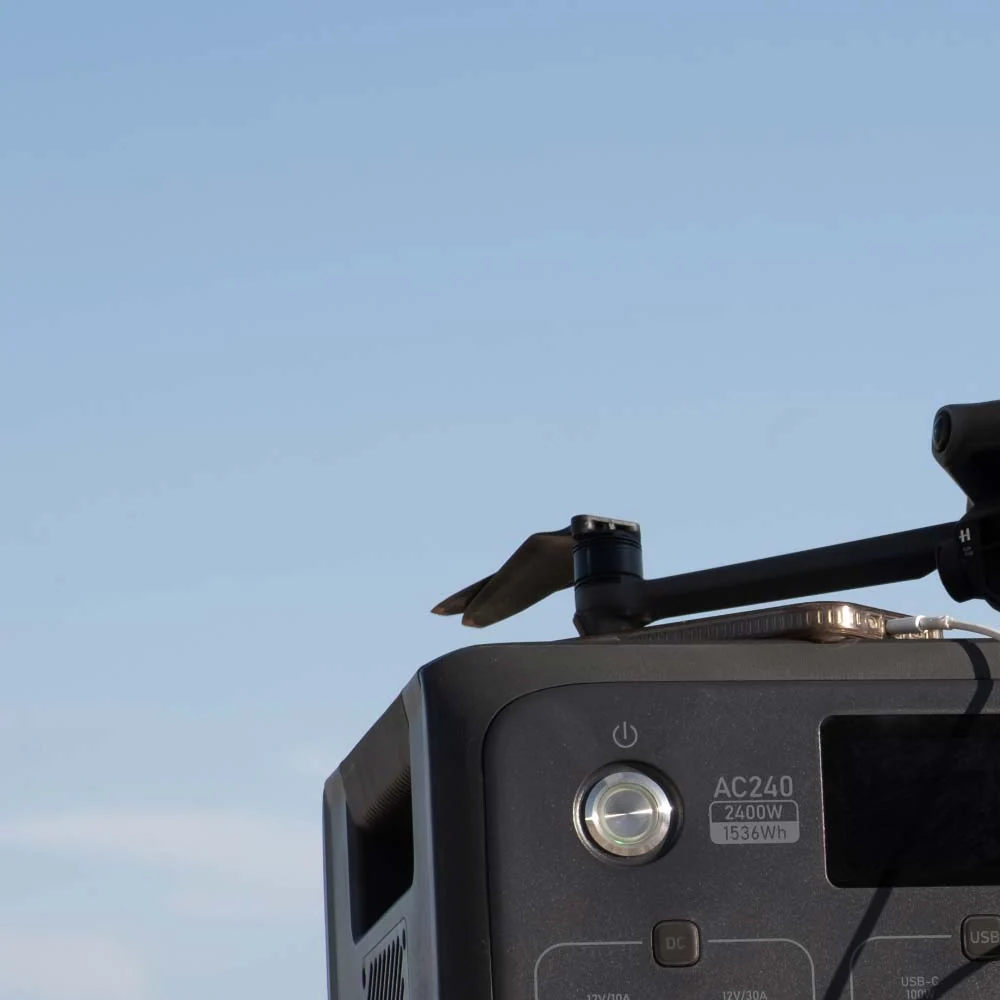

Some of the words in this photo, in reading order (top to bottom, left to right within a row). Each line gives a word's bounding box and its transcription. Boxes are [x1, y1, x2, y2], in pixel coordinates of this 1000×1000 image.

[713, 775, 794, 798] AC240
[724, 804, 783, 820] 2400W
[722, 825, 787, 841] 1536Wh
[665, 936, 688, 950] DC
[970, 931, 1000, 944] USB
[901, 975, 939, 987] USB-C
